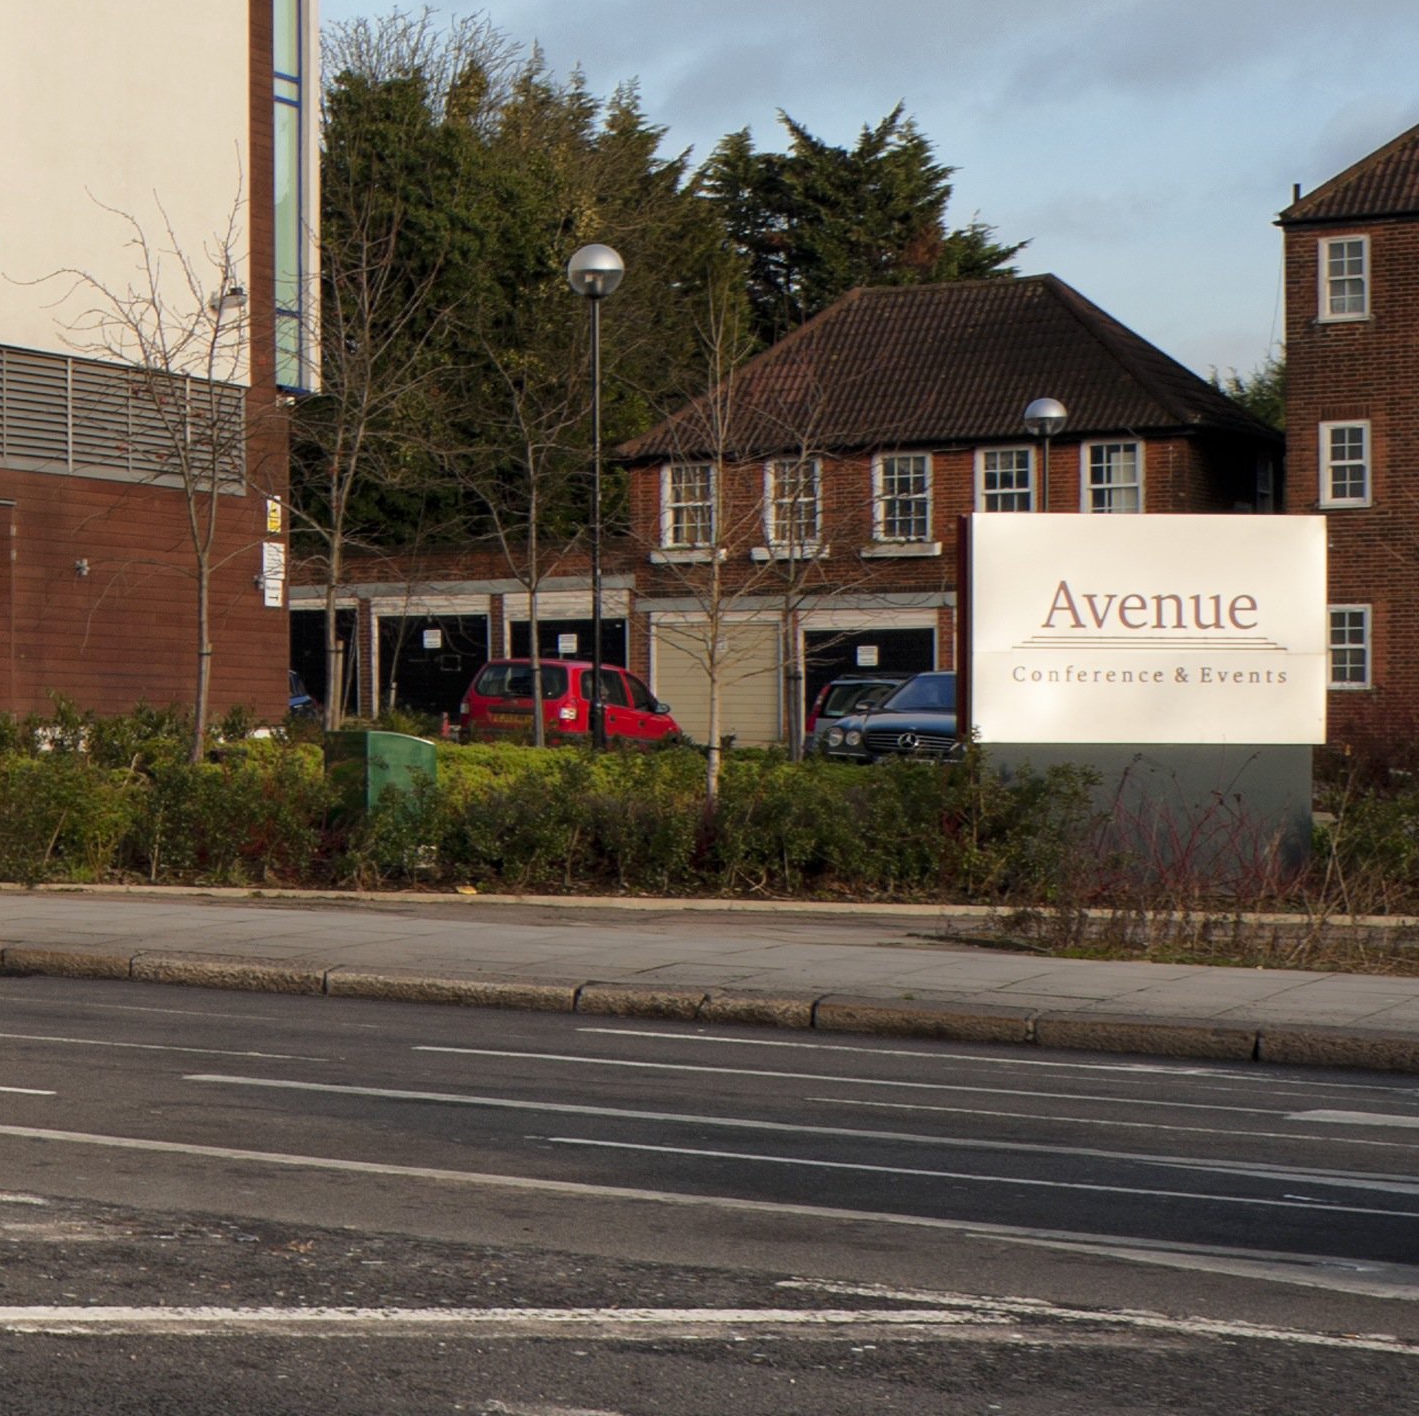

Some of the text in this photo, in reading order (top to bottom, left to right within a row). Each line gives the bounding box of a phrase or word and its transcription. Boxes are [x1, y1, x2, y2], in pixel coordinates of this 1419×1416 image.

[1041, 580, 1258, 629] Avenue
[1012, 665, 1288, 683] Conference & Events
